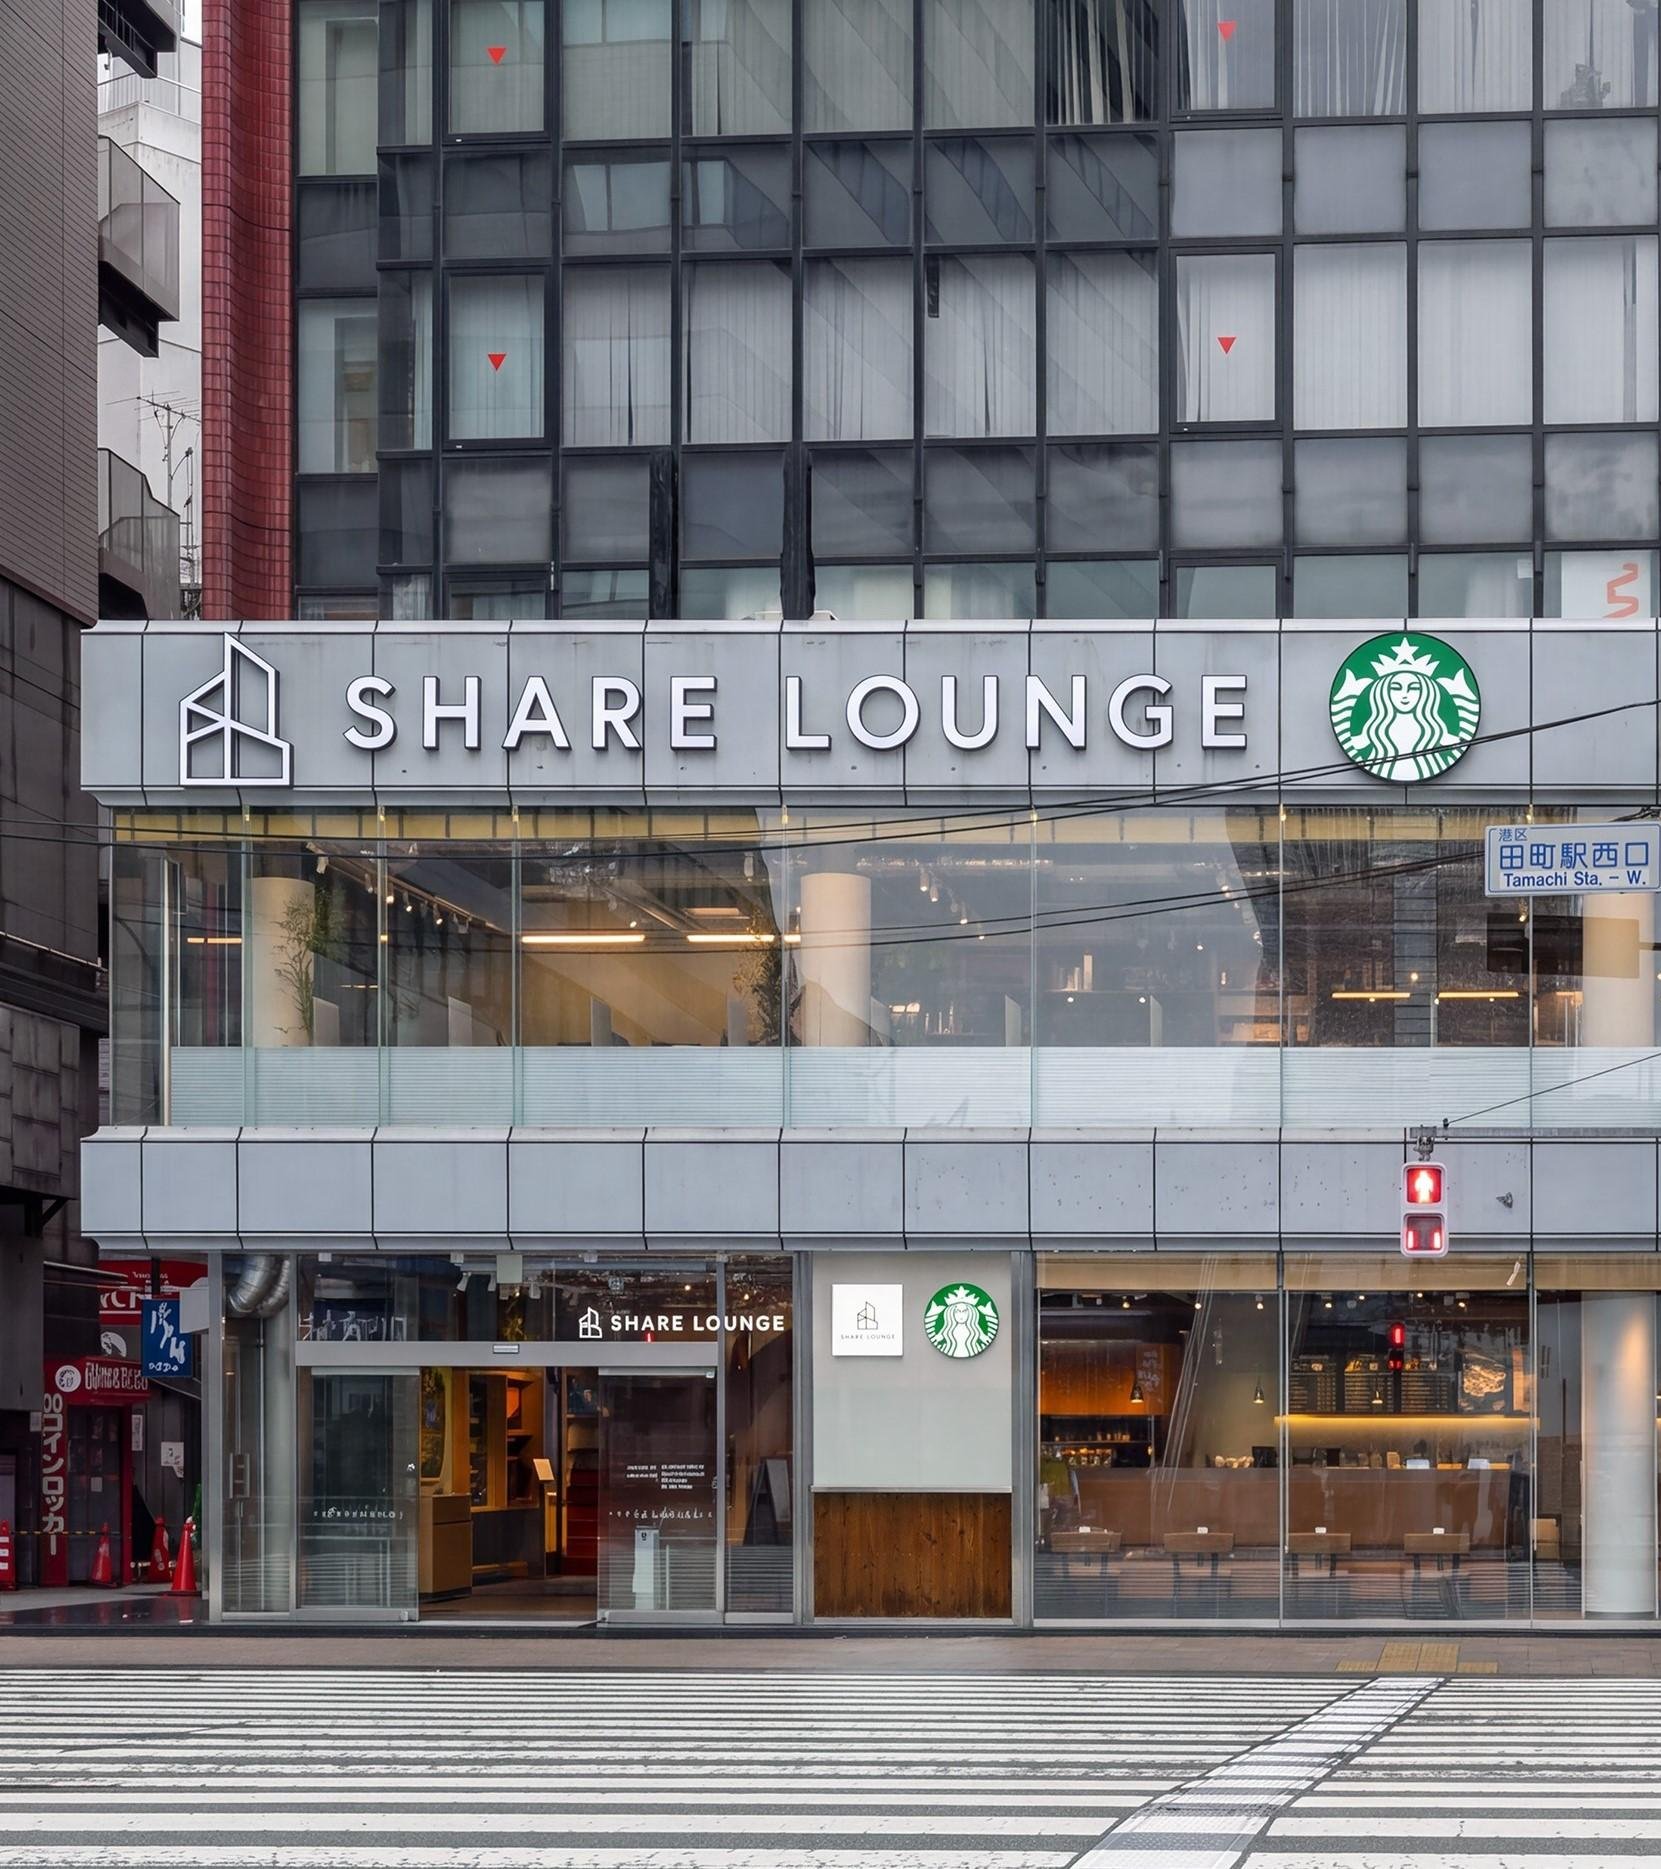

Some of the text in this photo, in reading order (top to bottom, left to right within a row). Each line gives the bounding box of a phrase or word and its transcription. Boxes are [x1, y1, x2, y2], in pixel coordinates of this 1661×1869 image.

[343, 673, 1249, 752] SHARE LOUNGE
[1498, 828, 1527, 841] 港区
[1500, 842, 1649, 870] 田町駅西口
[1504, 872, 1567, 887] Tamachi
[1574, 870, 1602, 886] Sta.
[1627, 870, 1646, 885] W.
[611, 1315, 785, 1332] SHARE LOUNGE
[43, 1413, 64, 1556] コインロッカー
